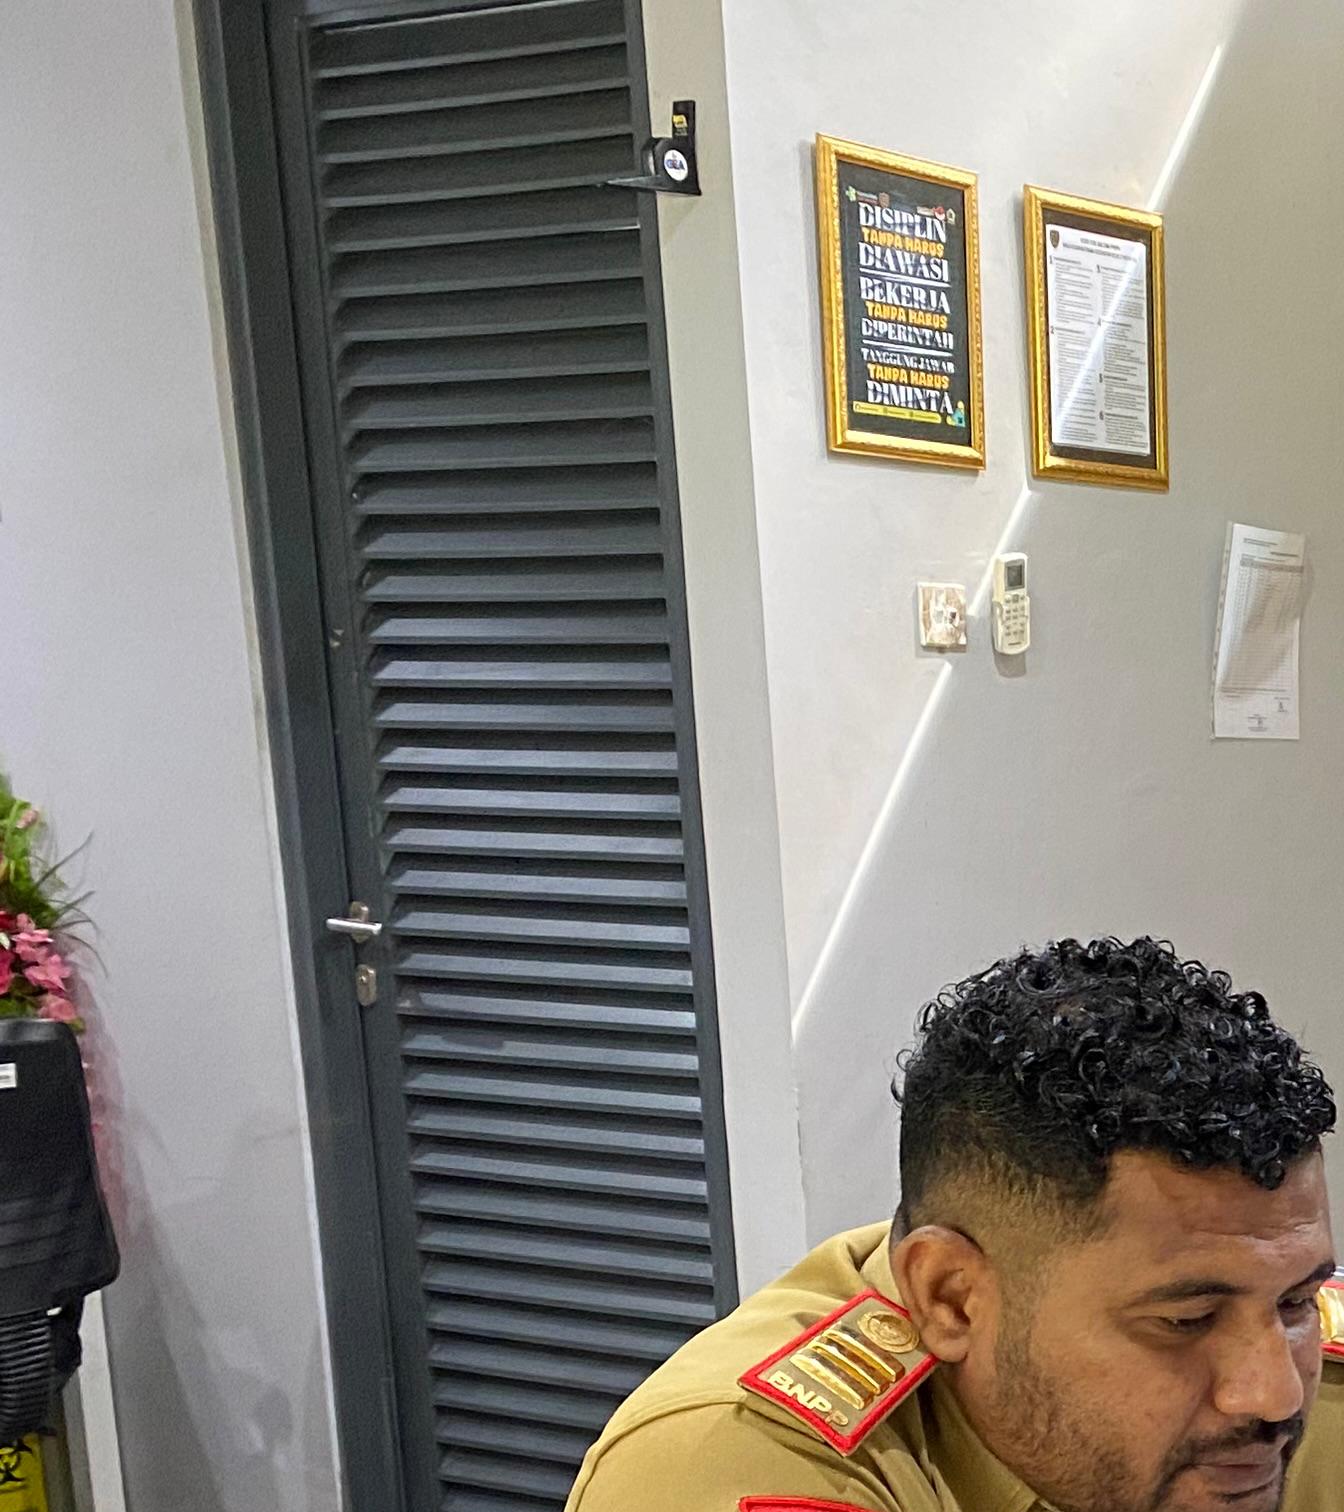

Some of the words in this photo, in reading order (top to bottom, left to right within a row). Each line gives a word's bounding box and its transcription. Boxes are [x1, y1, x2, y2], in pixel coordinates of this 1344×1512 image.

[858, 202, 946, 243] DISIPLIN
[861, 226, 903, 249] TANPA
[904, 237, 945, 258] HARUS
[858, 241, 949, 282] DIAWASI
[859, 276, 950, 314] BEKERJA
[865, 301, 907, 323] TANPA
[908, 308, 948, 330] HARUS
[861, 317, 954, 350] DIPERINTAH
[867, 362, 908, 384] TANPA
[910, 370, 950, 390] HARUS
[866, 380, 954, 414] DIMINTA
[767, 1370, 849, 1426] BNPP
